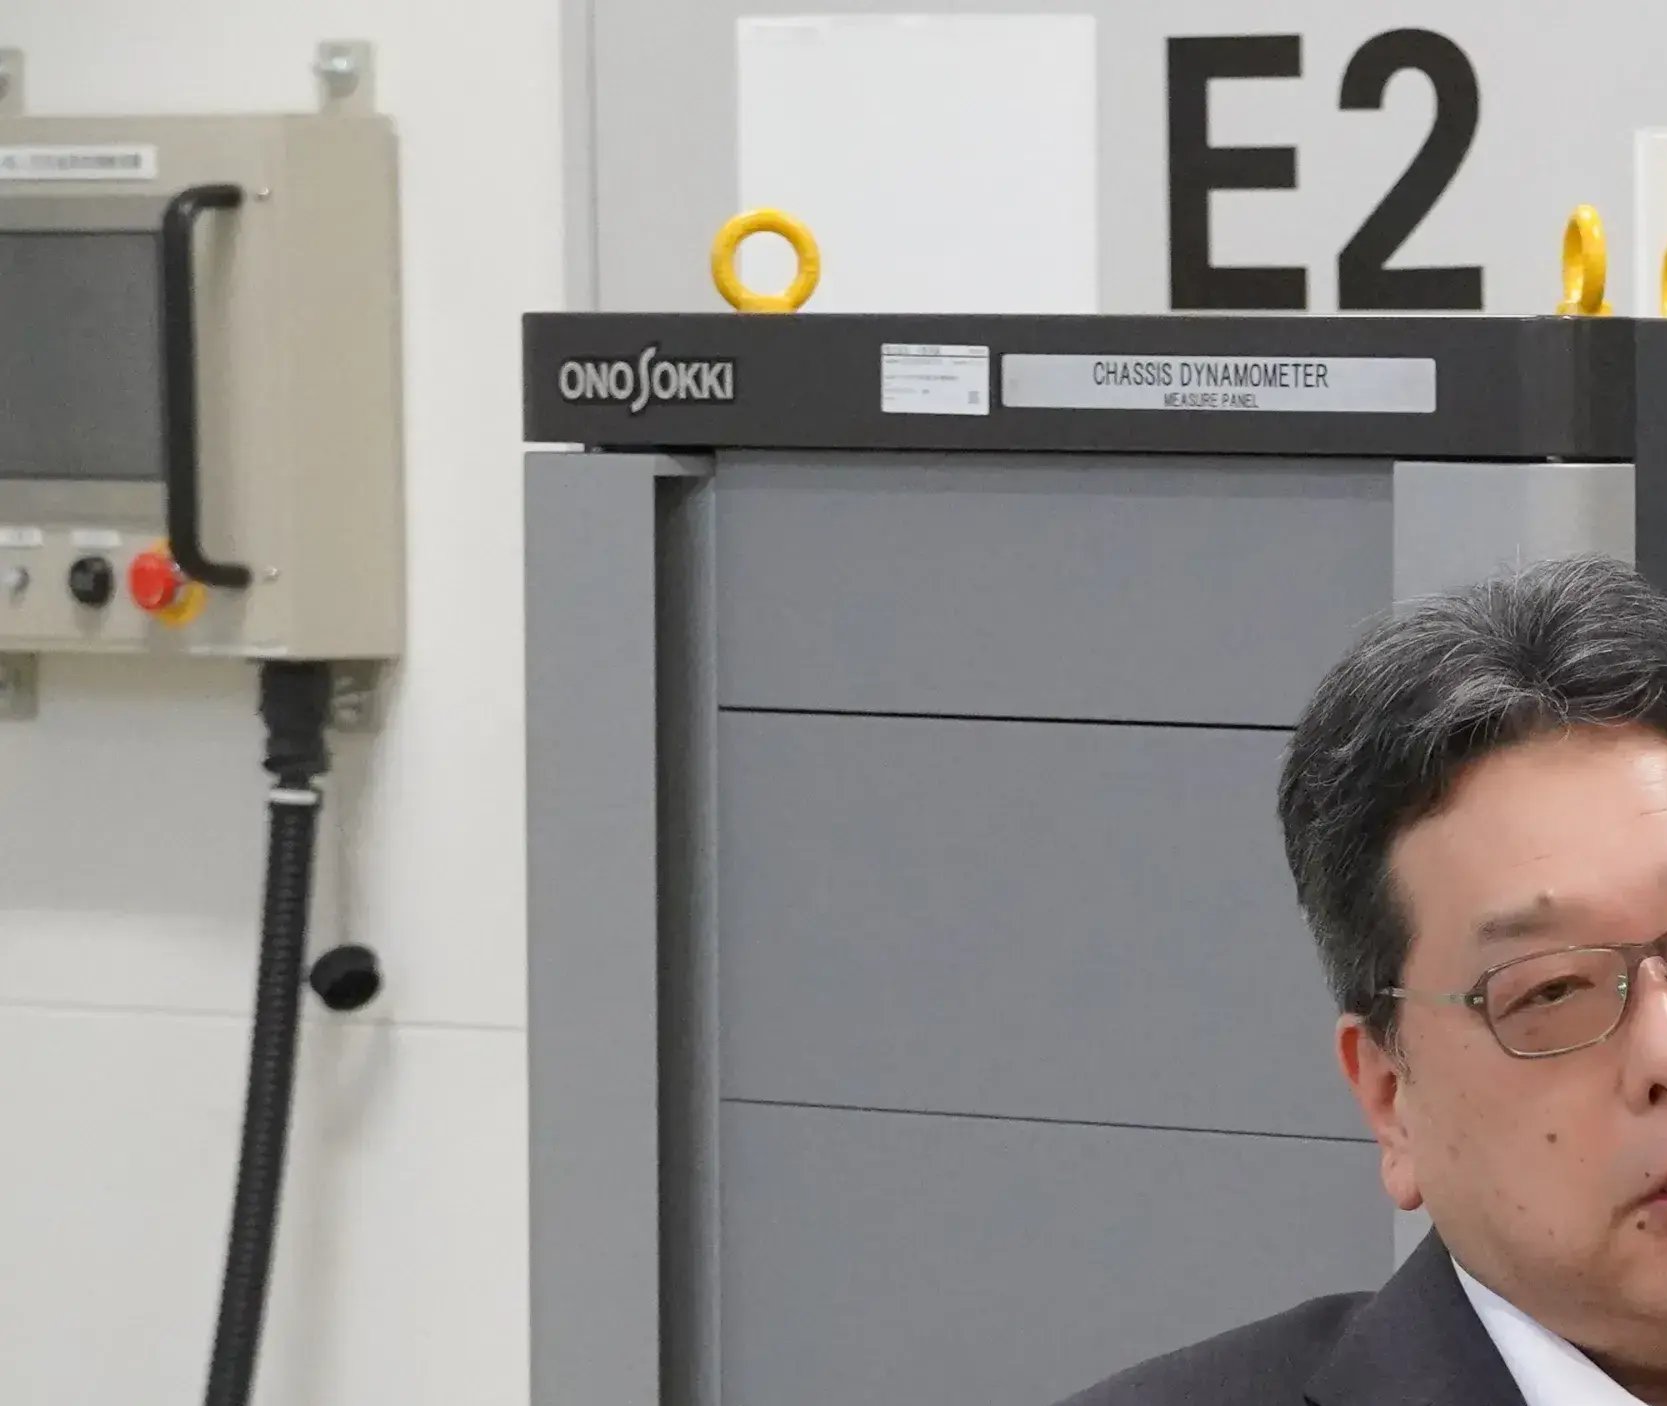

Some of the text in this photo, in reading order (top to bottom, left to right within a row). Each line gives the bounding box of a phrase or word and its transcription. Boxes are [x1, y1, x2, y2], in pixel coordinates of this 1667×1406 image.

[1167, 28, 1483, 310] E2
[1093, 361, 1329, 388] CHASSIS DYNAMOMETER
[1164, 391, 1259, 408] MEASURE PANEL
